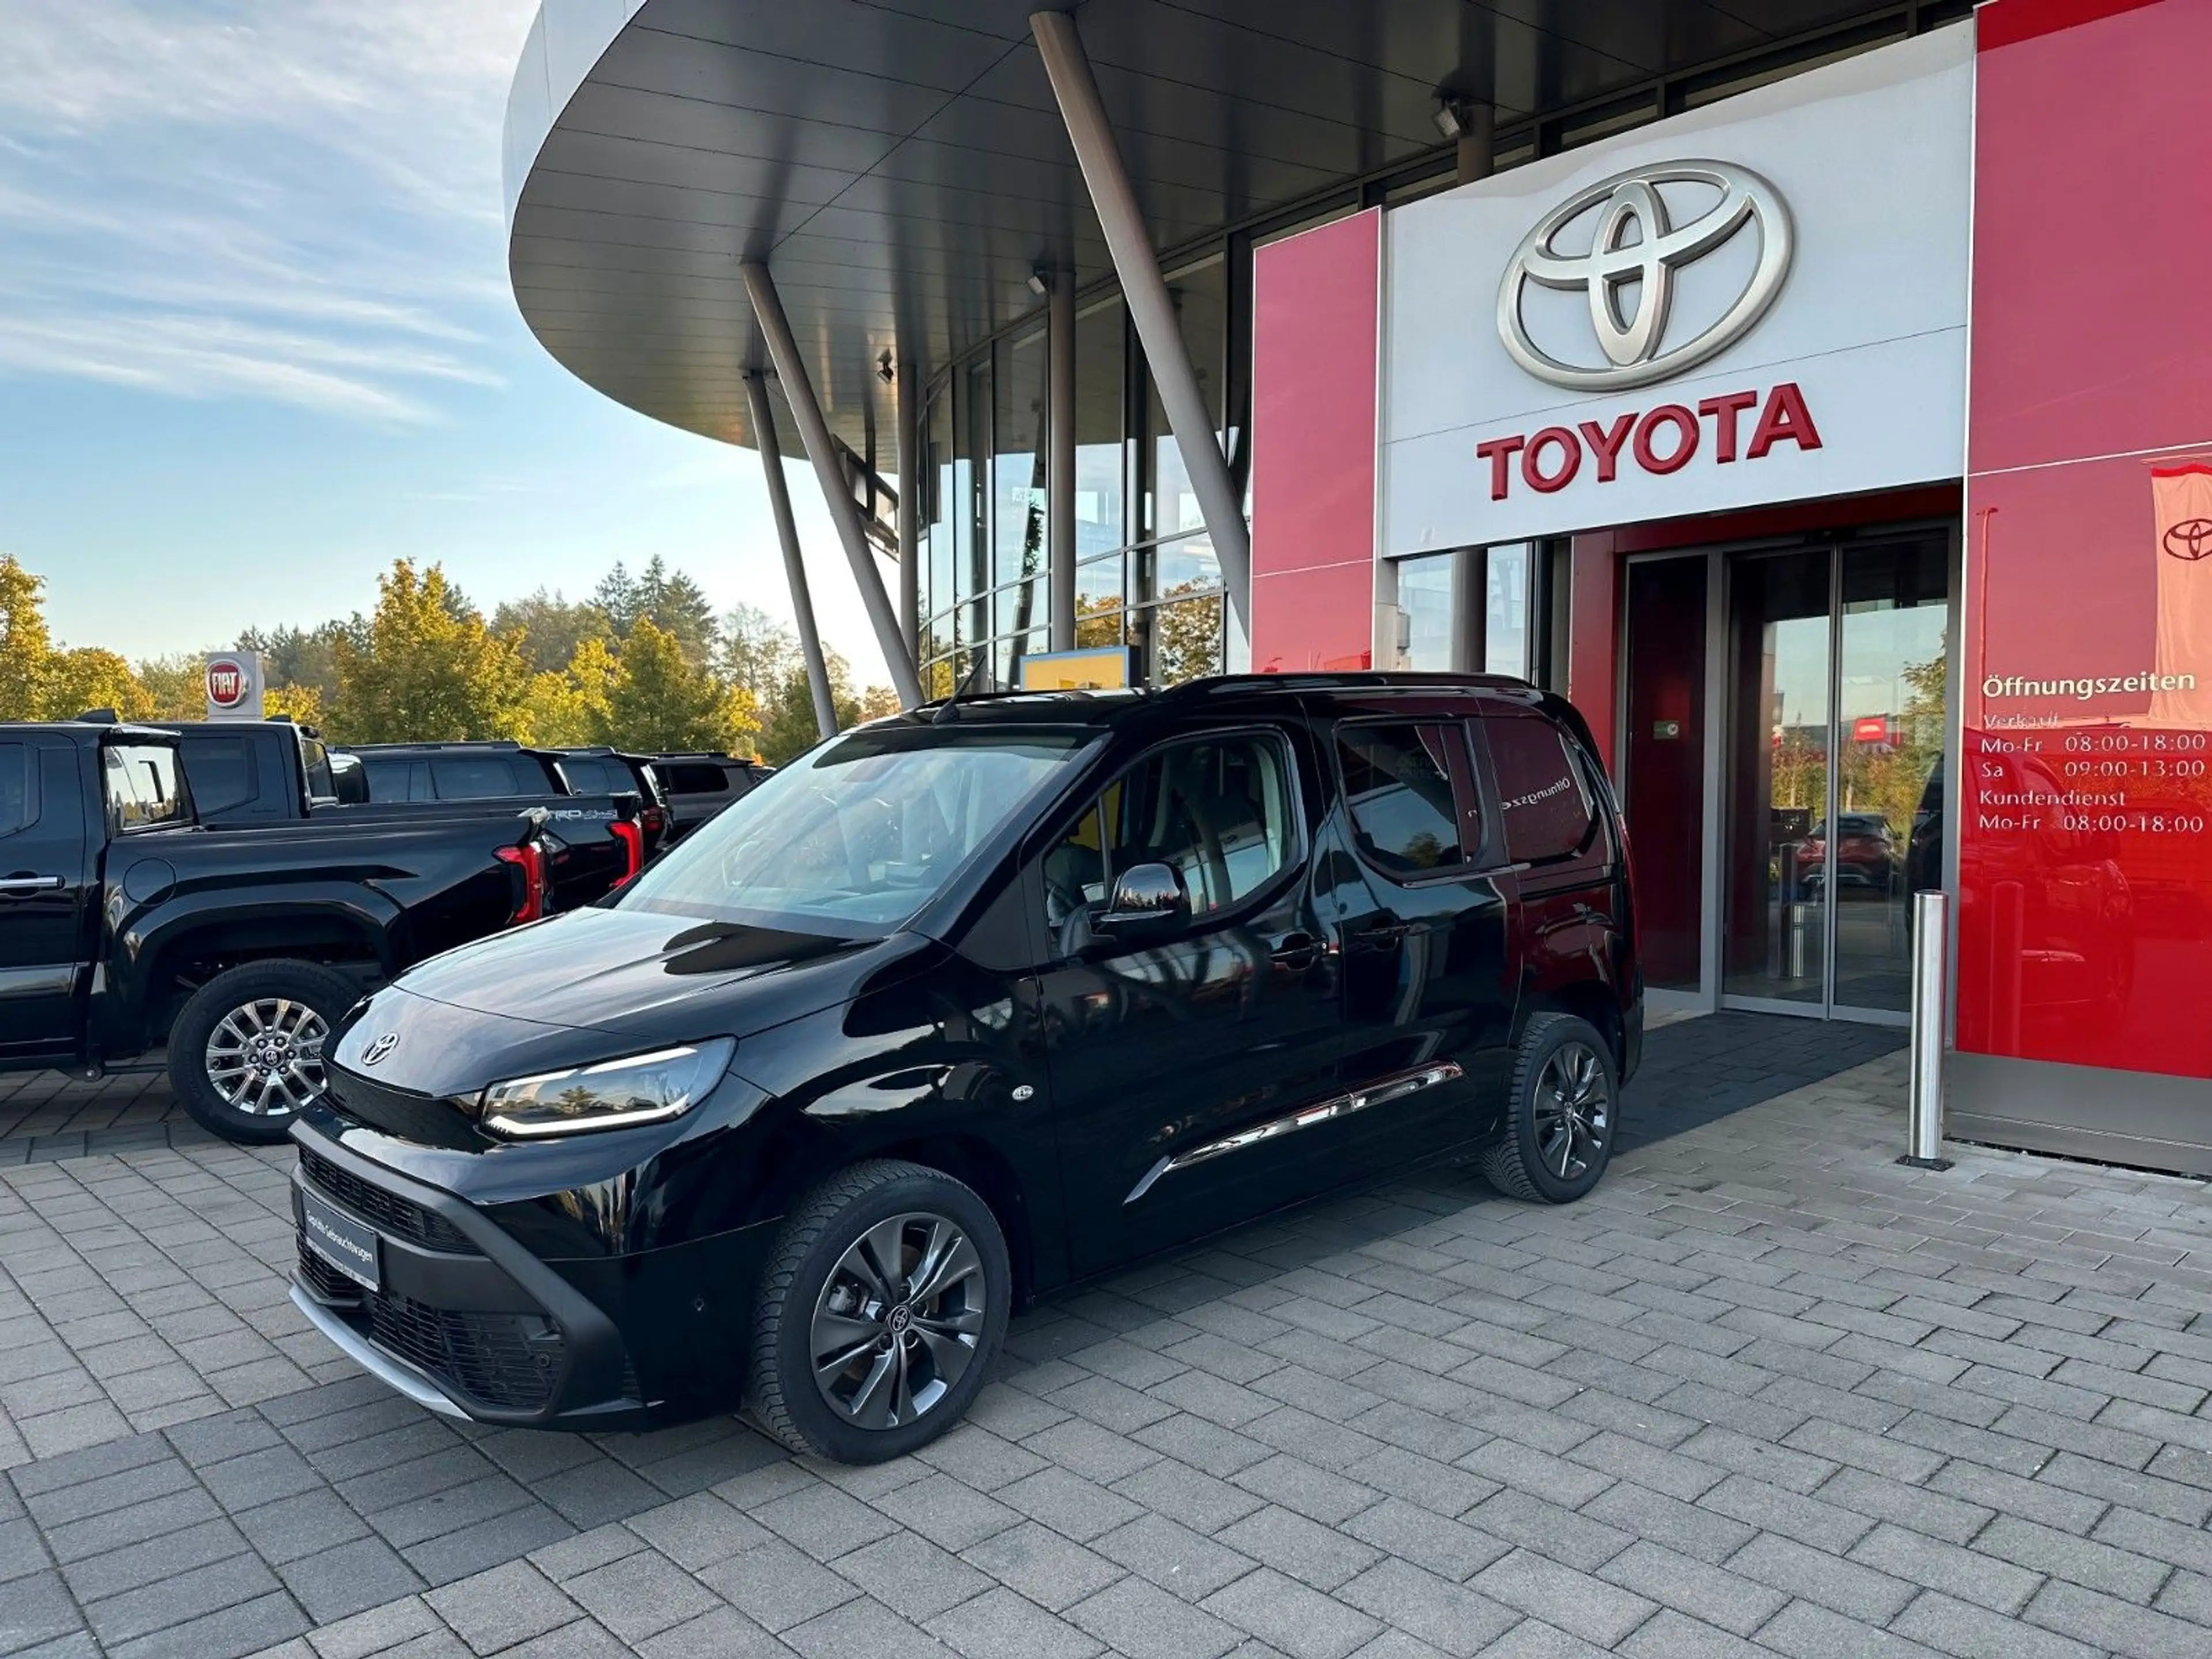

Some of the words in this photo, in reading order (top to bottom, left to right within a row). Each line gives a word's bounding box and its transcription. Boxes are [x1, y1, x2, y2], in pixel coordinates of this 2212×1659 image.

[1476, 382, 1823, 501] TOYOTA
[211, 672, 237, 695] FIAT
[1982, 671, 2195, 700] Öffnungszeiten
[1983, 710, 2059, 728] Verkauf
[1981, 736, 2043, 753] Mo-Fr
[2065, 734, 2206, 752] 08:00-18:00
[1981, 761, 2003, 778] Sa
[2065, 760, 2205, 777] 09:00-13:00
[1980, 790, 2125, 806] Kundendienst
[1979, 814, 2041, 830] Mo-Fr
[2063, 815, 2204, 832] 08:00-18:00
